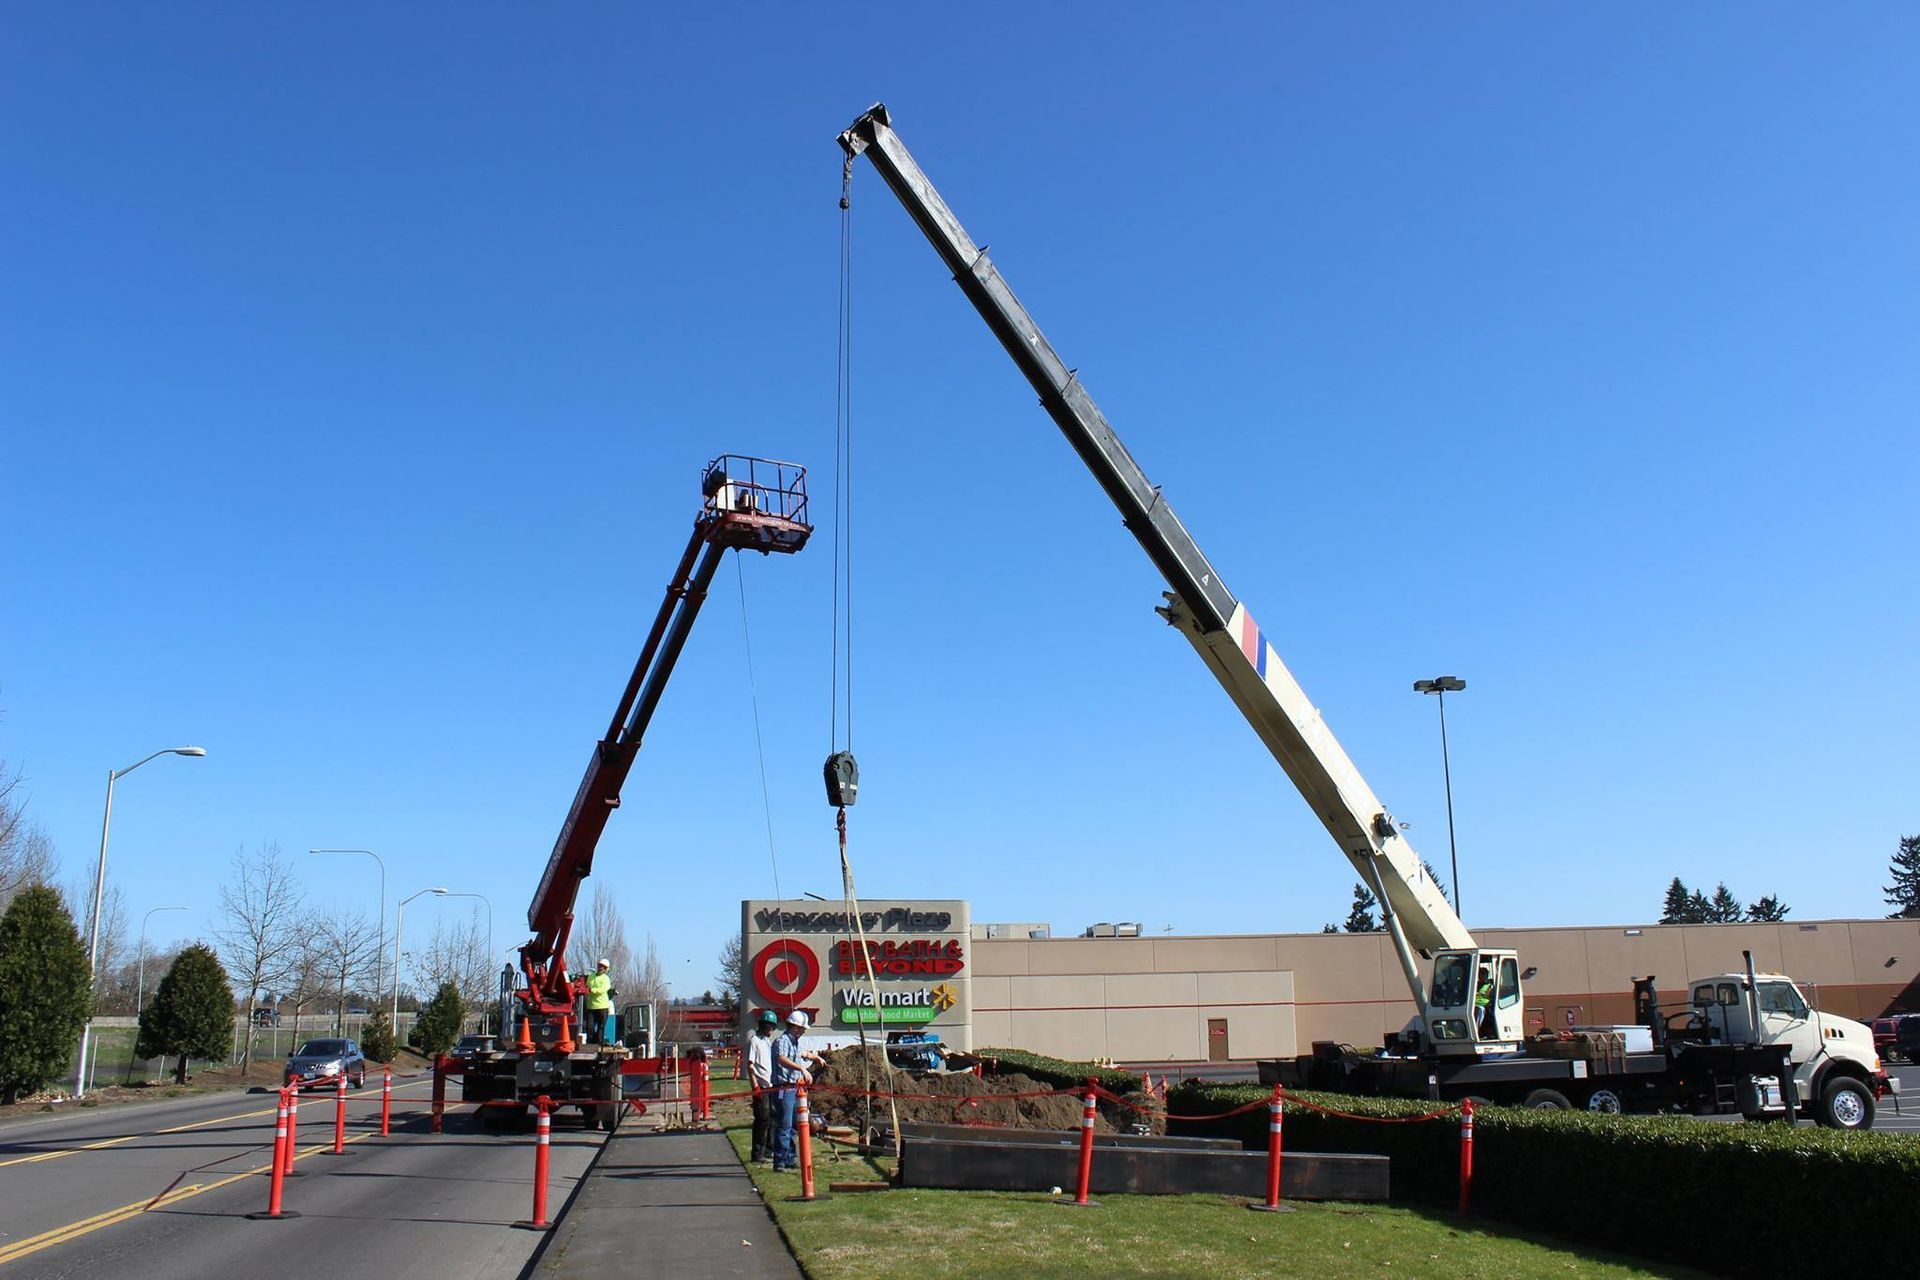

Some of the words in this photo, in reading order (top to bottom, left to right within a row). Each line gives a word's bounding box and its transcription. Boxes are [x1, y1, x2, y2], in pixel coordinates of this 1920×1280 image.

[885, 907, 951, 928] Plaza
[838, 940, 880, 957] BED
[884, 940, 941, 957] BATH
[946, 939, 963, 957] &
[838, 959, 964, 974] BEYOND
[846, 1010, 900, 1021] Neghbohood
[902, 1010, 930, 1019] Market
